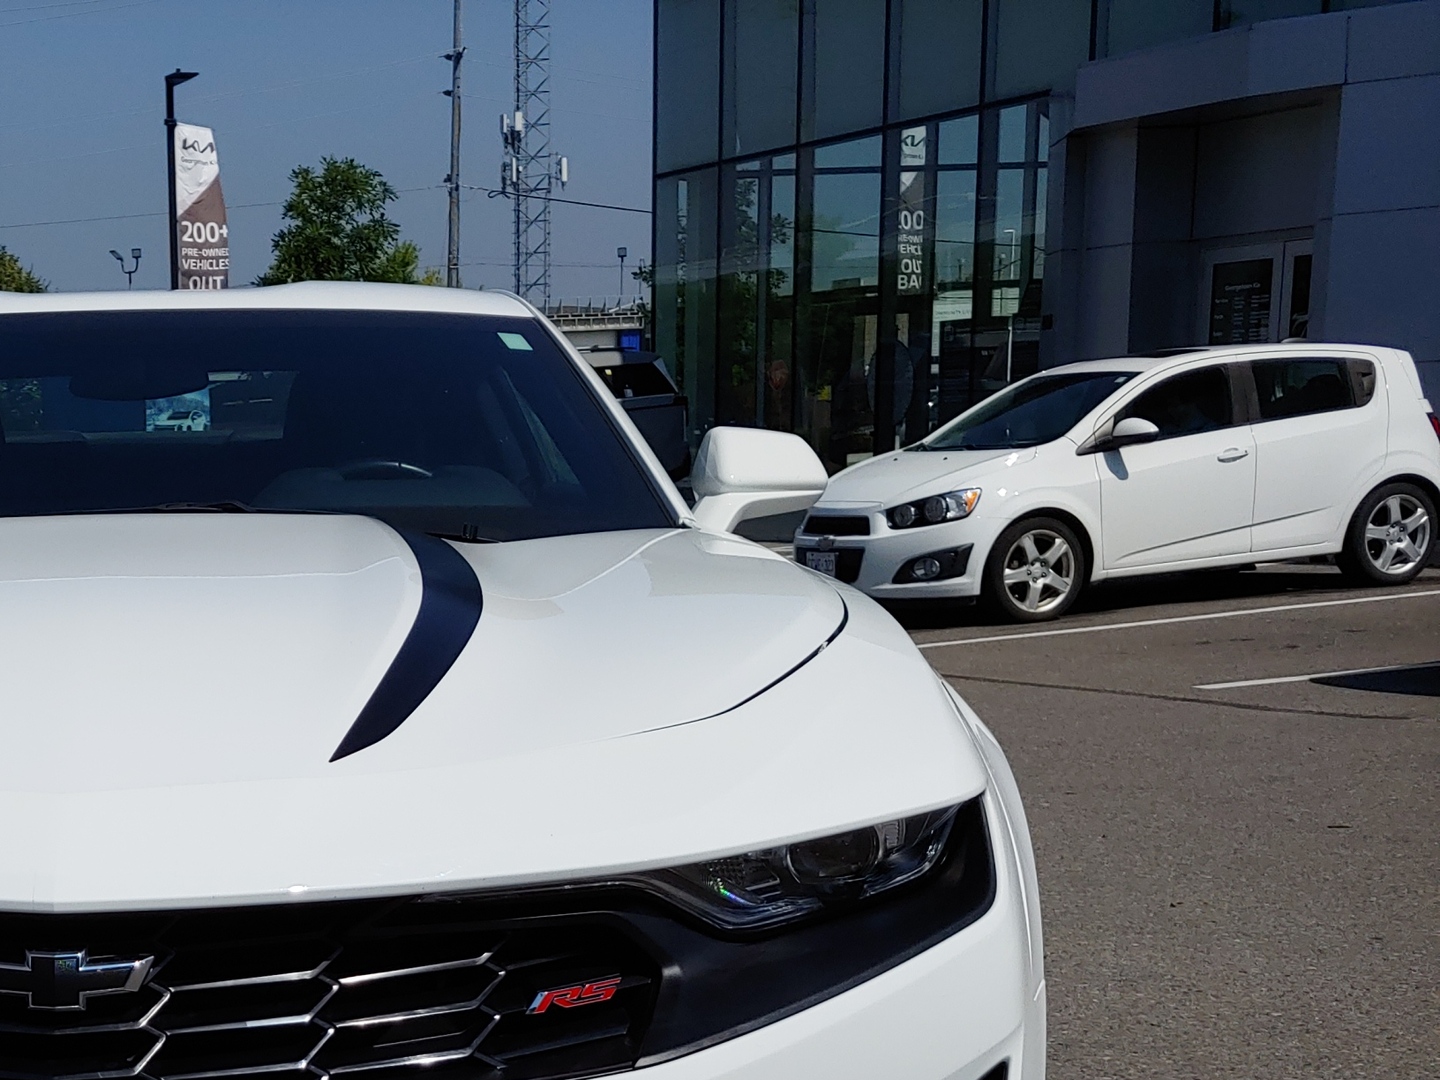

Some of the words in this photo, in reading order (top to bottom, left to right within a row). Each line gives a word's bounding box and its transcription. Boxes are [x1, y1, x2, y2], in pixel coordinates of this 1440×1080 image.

[182, 137, 216, 154] KIA
[898, 210, 925, 230] 00
[181, 220, 228, 243] 200+
[182, 258, 229, 270] VEHICLES
[526, 977, 622, 1014] RS
